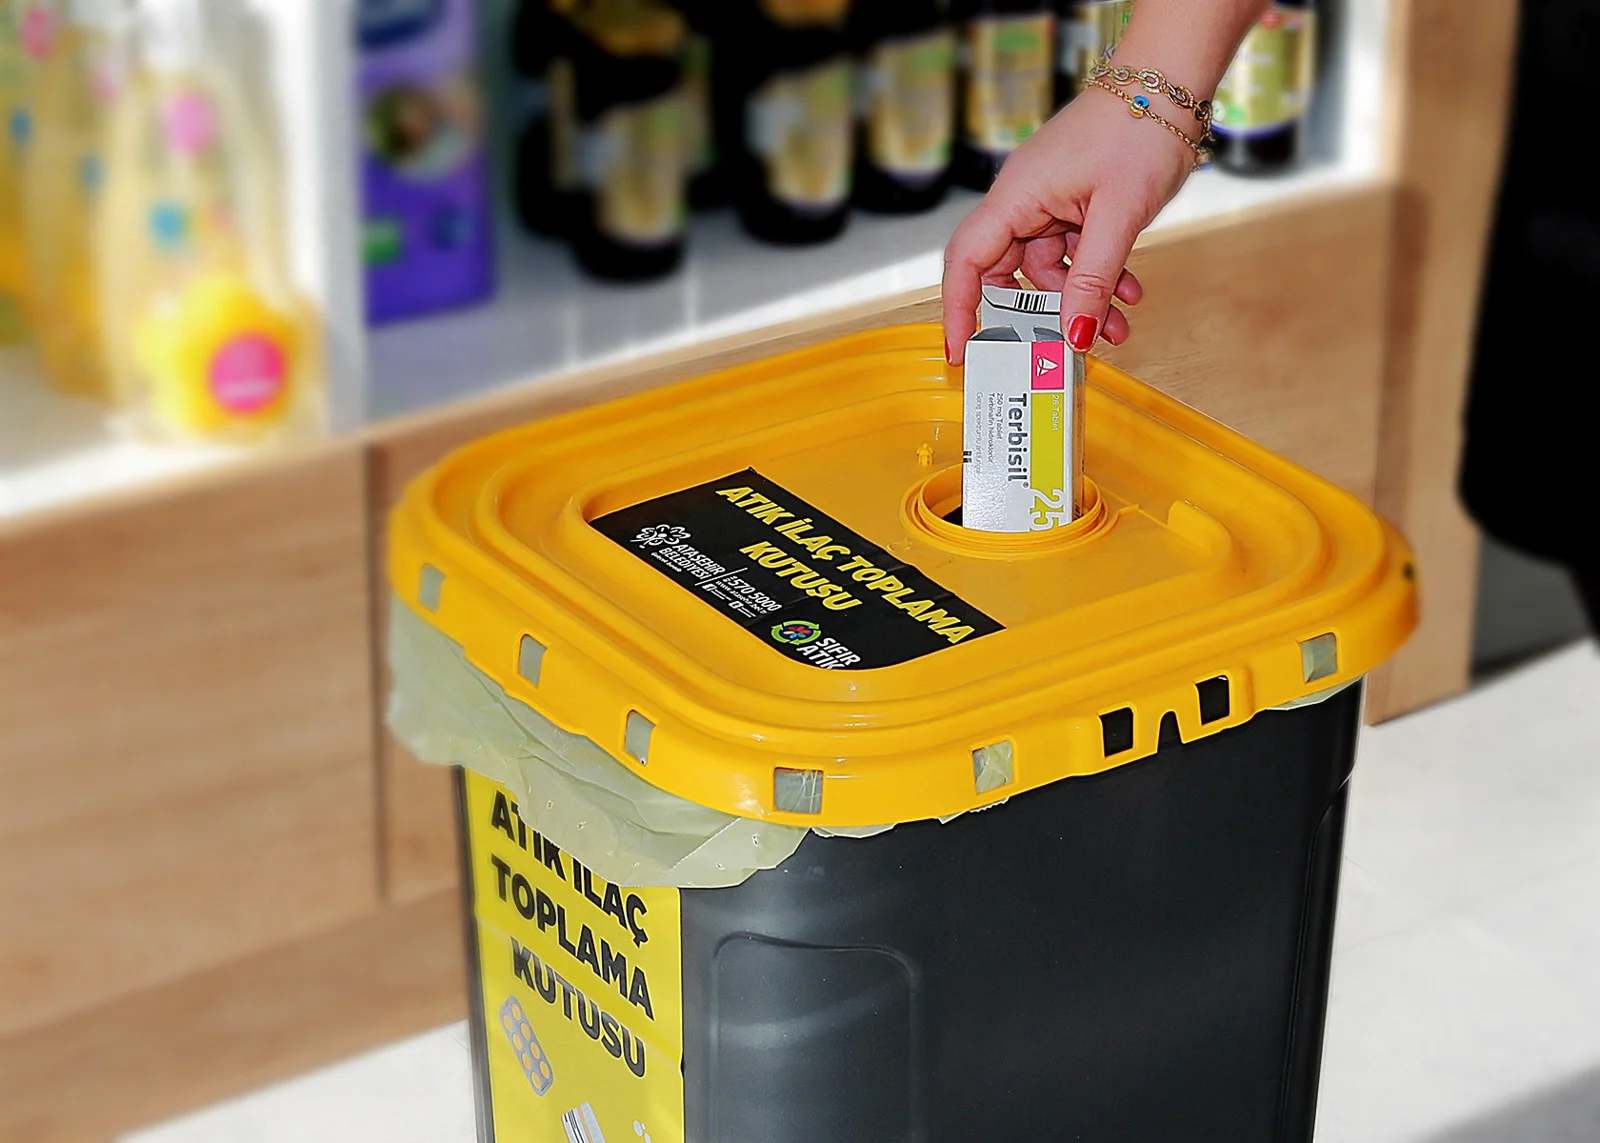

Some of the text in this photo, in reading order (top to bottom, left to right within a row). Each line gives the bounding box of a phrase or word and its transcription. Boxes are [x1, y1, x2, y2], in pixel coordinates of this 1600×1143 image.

[995, 392, 1004, 440] 250 mg Tablet
[1051, 394, 1060, 432] 28 Tablet
[715, 486, 976, 645] ATIK İLAÇ TOPLAMA
[728, 578, 756, 594] 570
[748, 591, 783, 612] 5000
[738, 540, 863, 612] KUTUSU
[796, 645, 845, 670] ATIK
[815, 637, 861, 666] SIFIR
[491, 789, 567, 882] ATIK
[490, 853, 655, 1021] TOPLAMA
[510, 936, 646, 1078] KUTUSU
